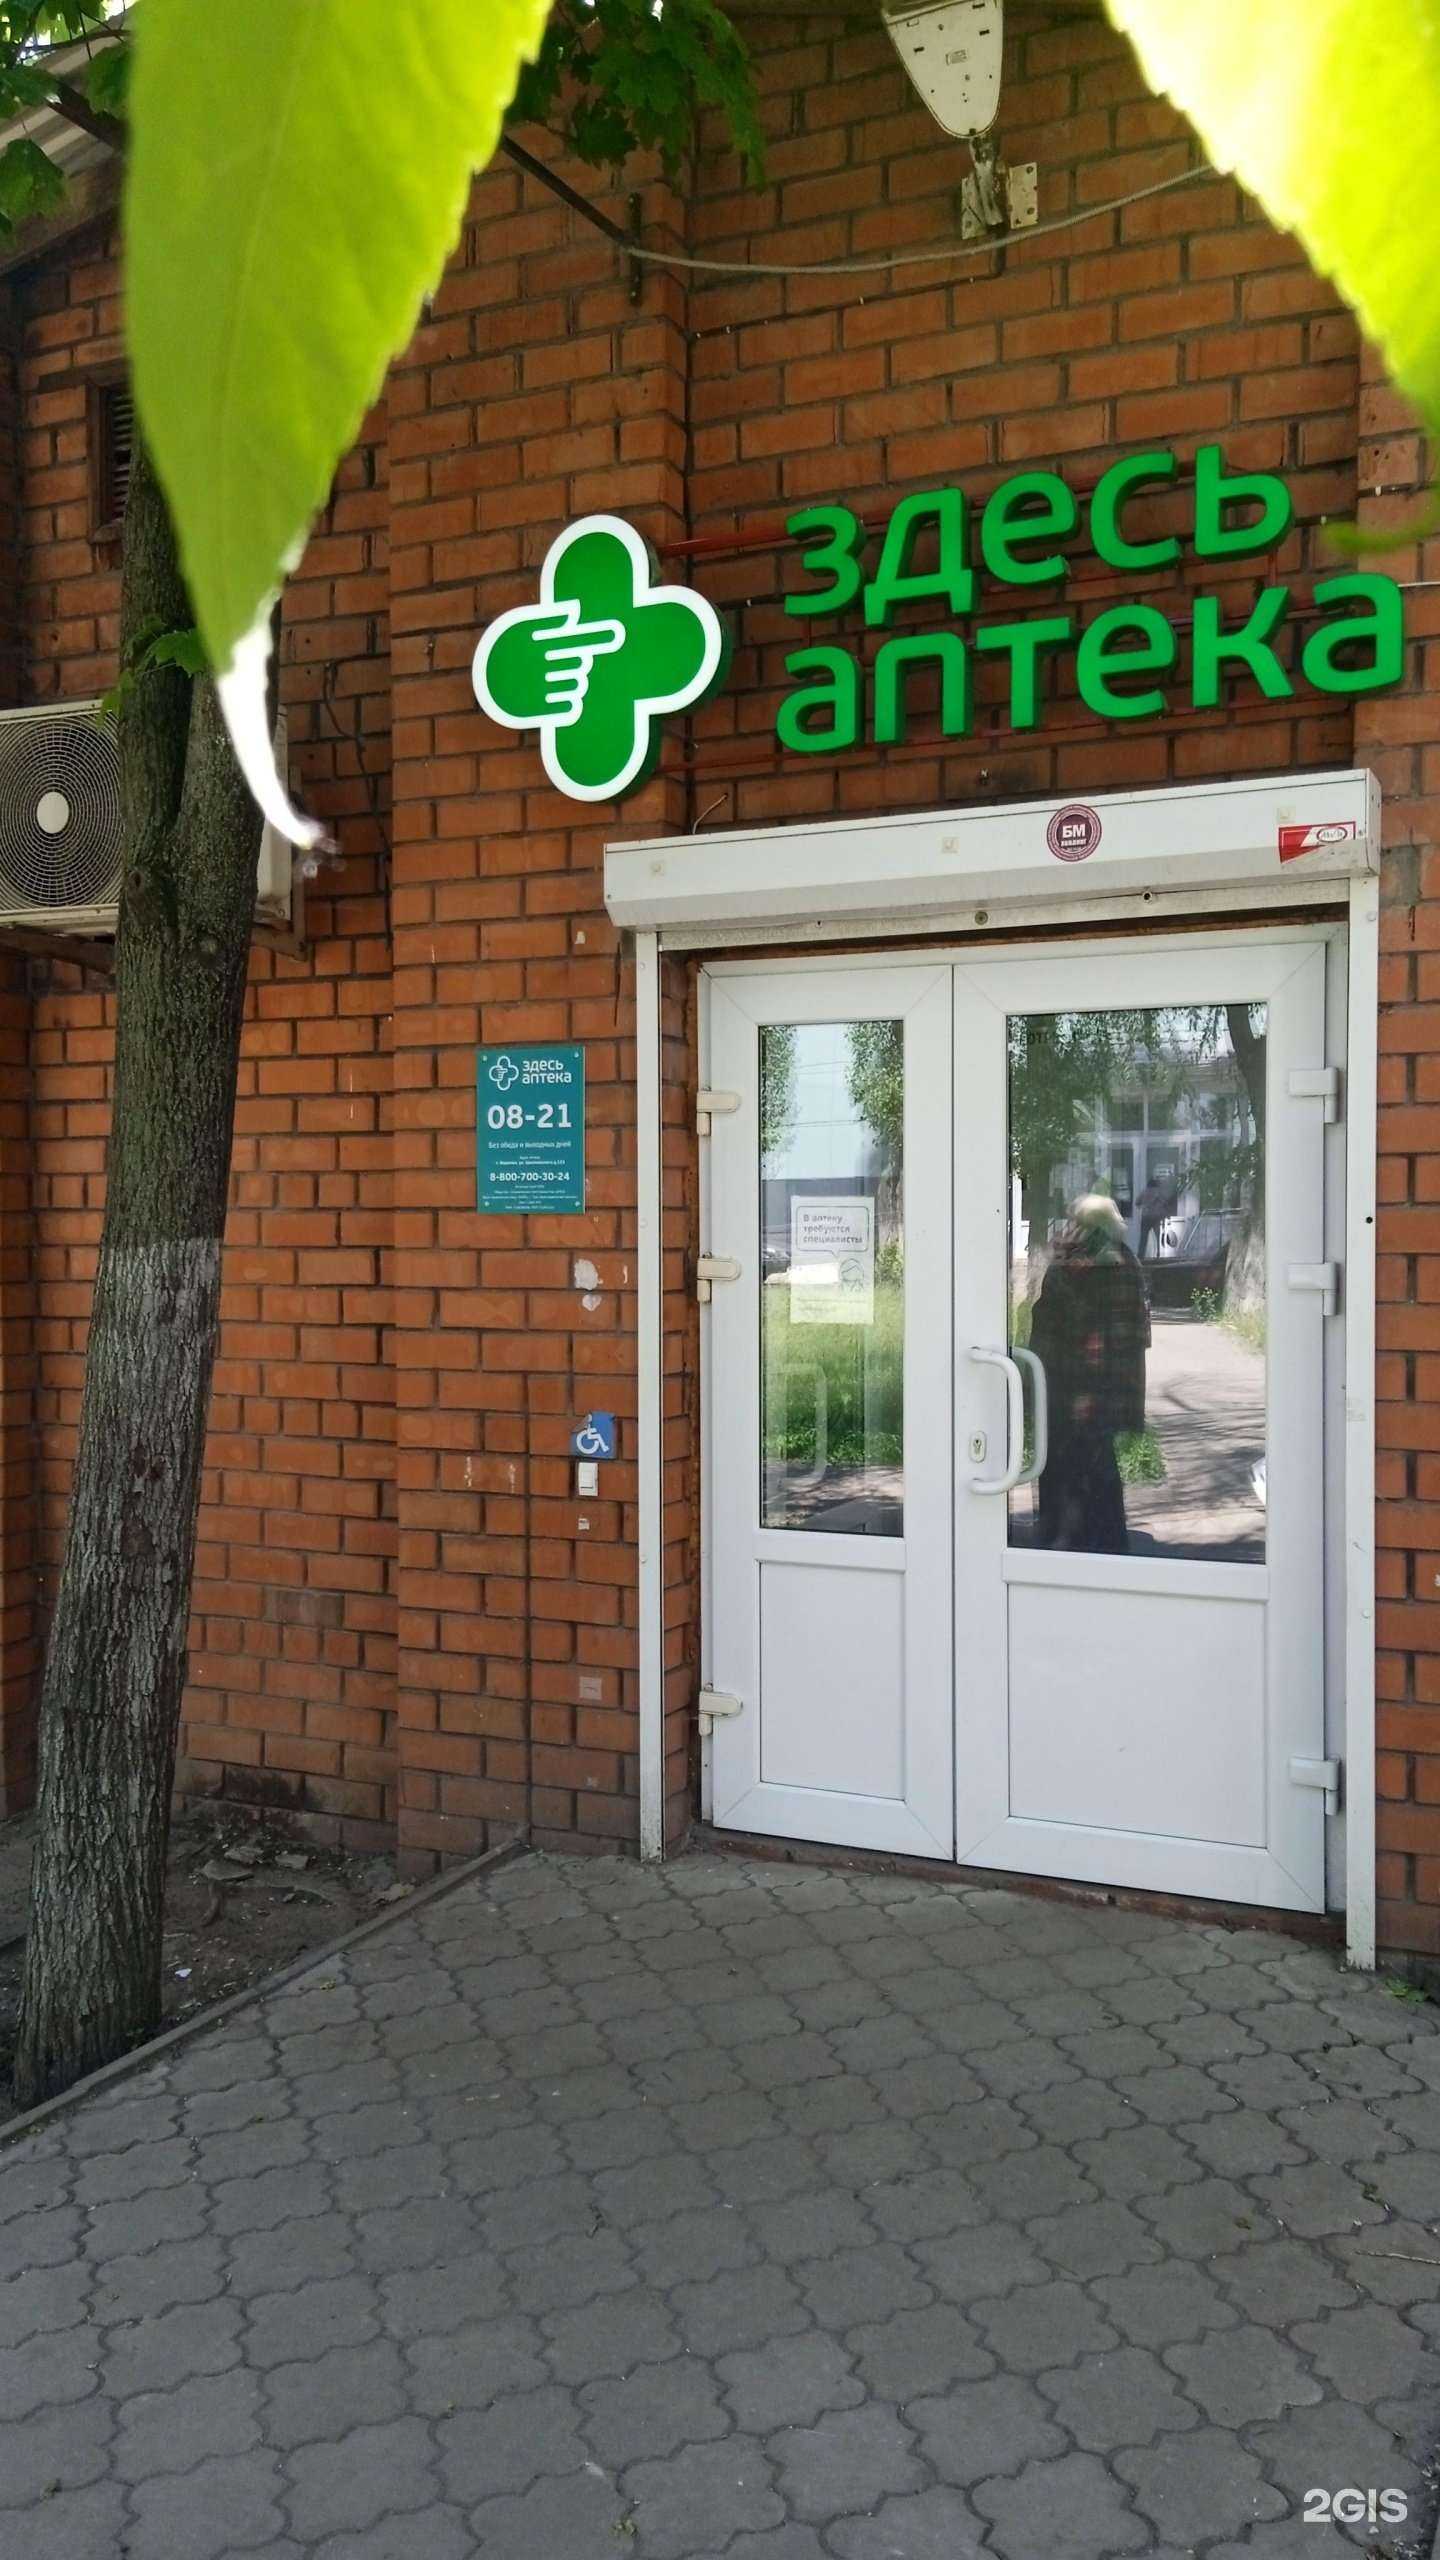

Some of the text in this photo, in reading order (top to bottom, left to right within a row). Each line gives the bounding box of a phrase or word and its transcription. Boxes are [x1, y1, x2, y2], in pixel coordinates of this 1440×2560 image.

[784, 444, 1294, 629] здесь
[776, 573, 1406, 752] аптека
[1062, 824, 1086, 838] БМ
[522, 1060, 564, 1073] здесь
[522, 1072, 572, 1084] аптека
[487, 1103, 572, 1129] 08-21
[803, 1236, 863, 1244] специалисты
